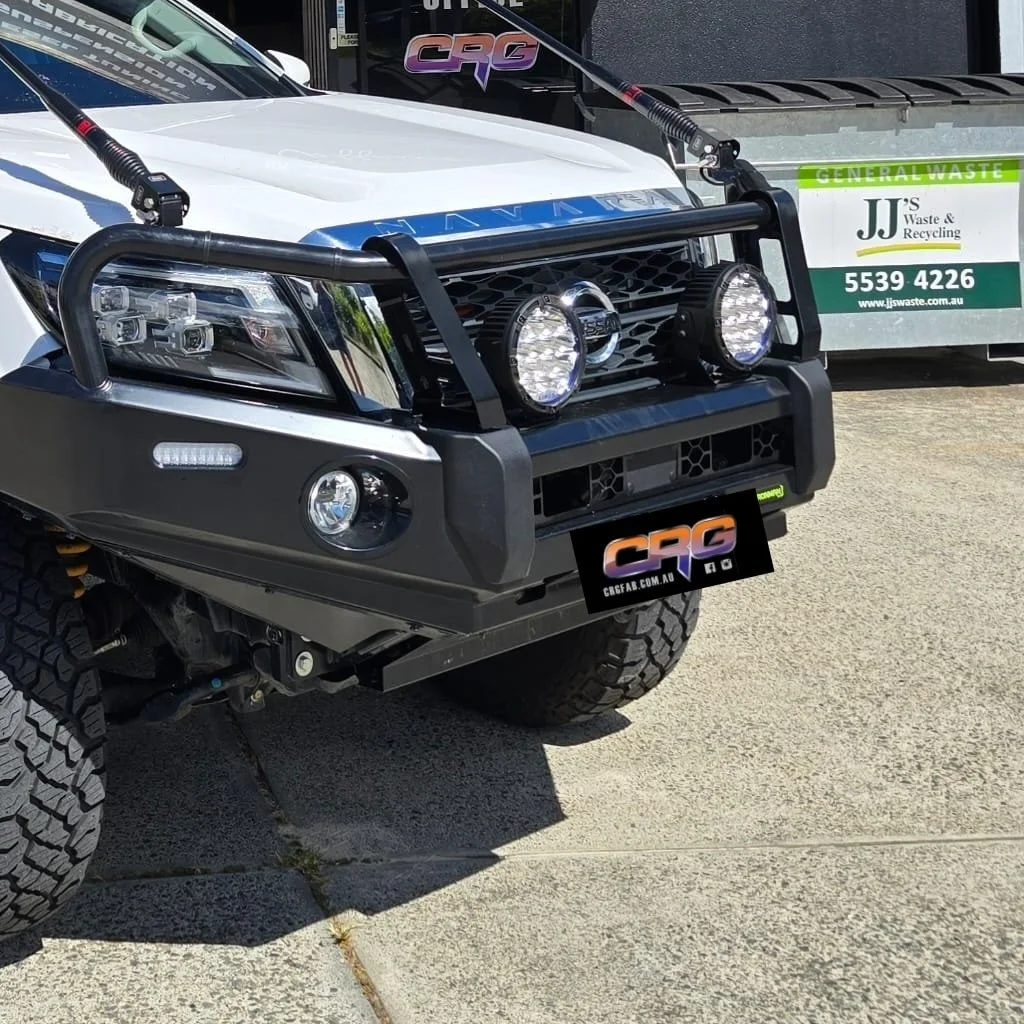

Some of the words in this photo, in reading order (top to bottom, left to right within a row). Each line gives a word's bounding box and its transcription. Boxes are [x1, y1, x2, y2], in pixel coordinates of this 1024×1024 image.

[403, 31, 541, 93] CRG
[815, 164, 922, 183] GENERAL
[927, 162, 1003, 181] WASTE
[903, 213, 940, 225] Waste
[943, 213, 955, 224] &
[903, 227, 961, 241] Recycling
[845, 271, 905, 293] 5539
[914, 268, 975, 290] 4226
[858, 296, 964, 309] www.jjswaste.com.au
